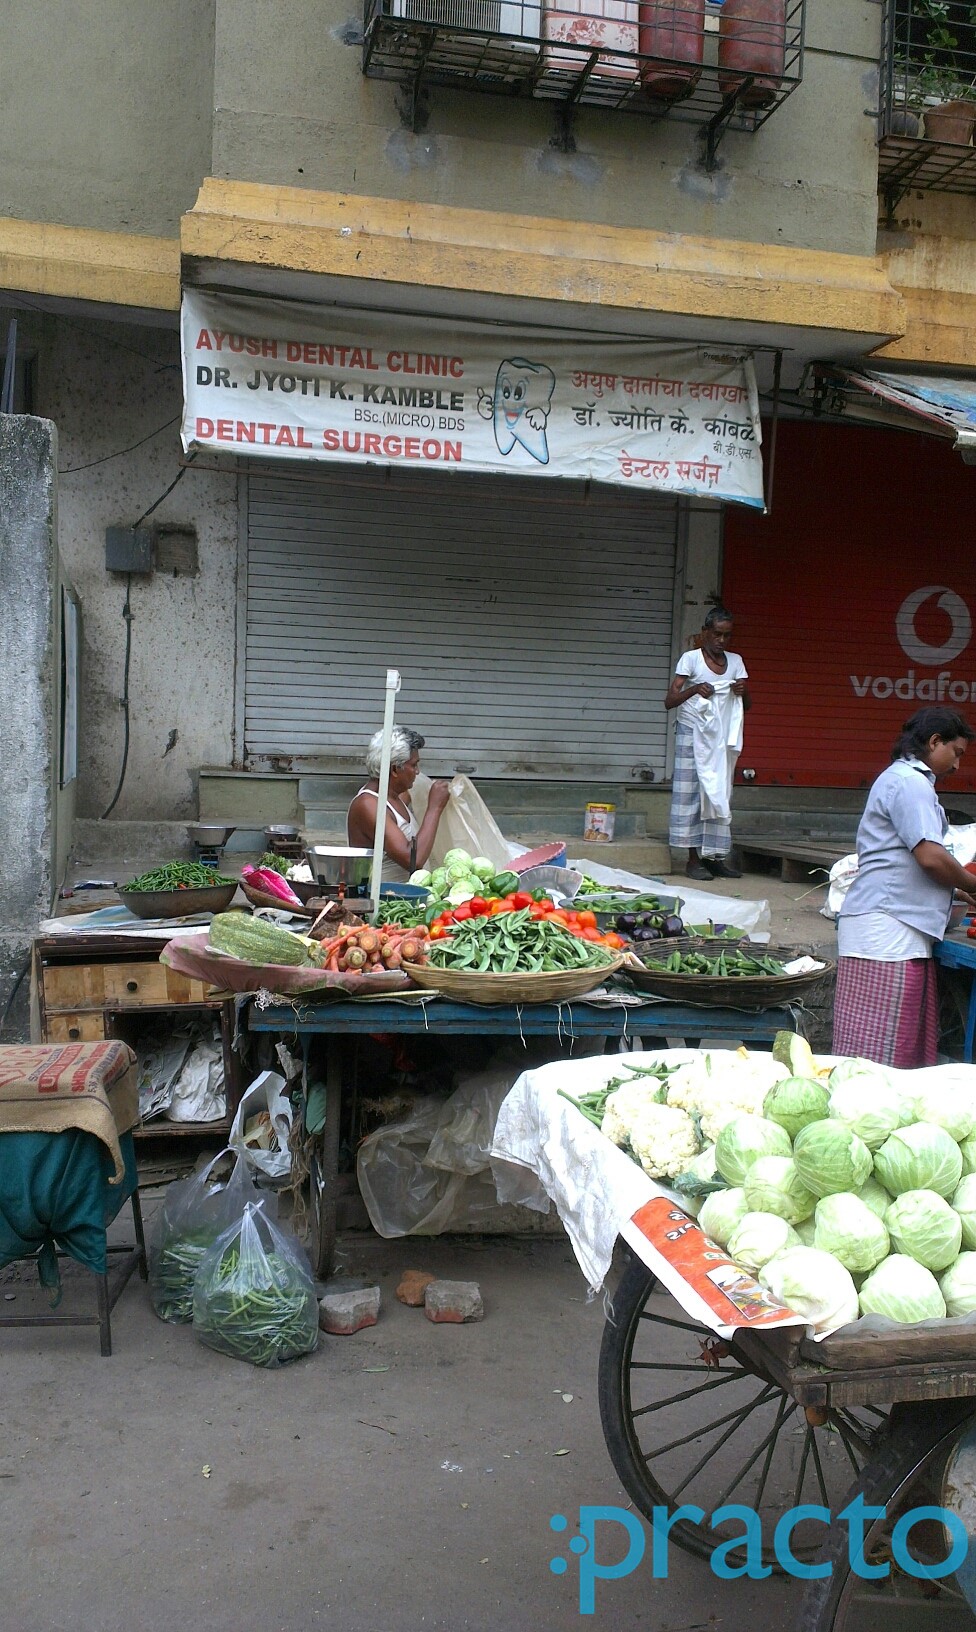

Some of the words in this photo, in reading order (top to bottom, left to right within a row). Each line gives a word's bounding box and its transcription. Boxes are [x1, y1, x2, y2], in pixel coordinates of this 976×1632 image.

[196, 328, 278, 359] AYUSH
[286, 341, 379, 370] DENTAL
[386, 351, 465, 378] CLINIC
[196, 365, 238, 389] DR.
[247, 369, 320, 397] JYOTI
[329, 380, 354, 401] K.
[363, 385, 465, 412] KAMBLE
[571, 370, 619, 397] अयुष
[622, 373, 685, 398] दातांचा
[195, 417, 313, 449] DENTAL
[322, 428, 463, 462] SURGEON
[354, 408, 435, 432] BSc.(MICRO)
[438, 414, 465, 432] BDS
[571, 402, 601, 428] डॉ.
[607, 405, 665, 432] ज्योति
[669, 408, 695, 435] के.
[702, 414, 757, 442] कांबळे
[617, 449, 670, 480] डेन्टल
[675, 454, 723, 485] सर्जन
